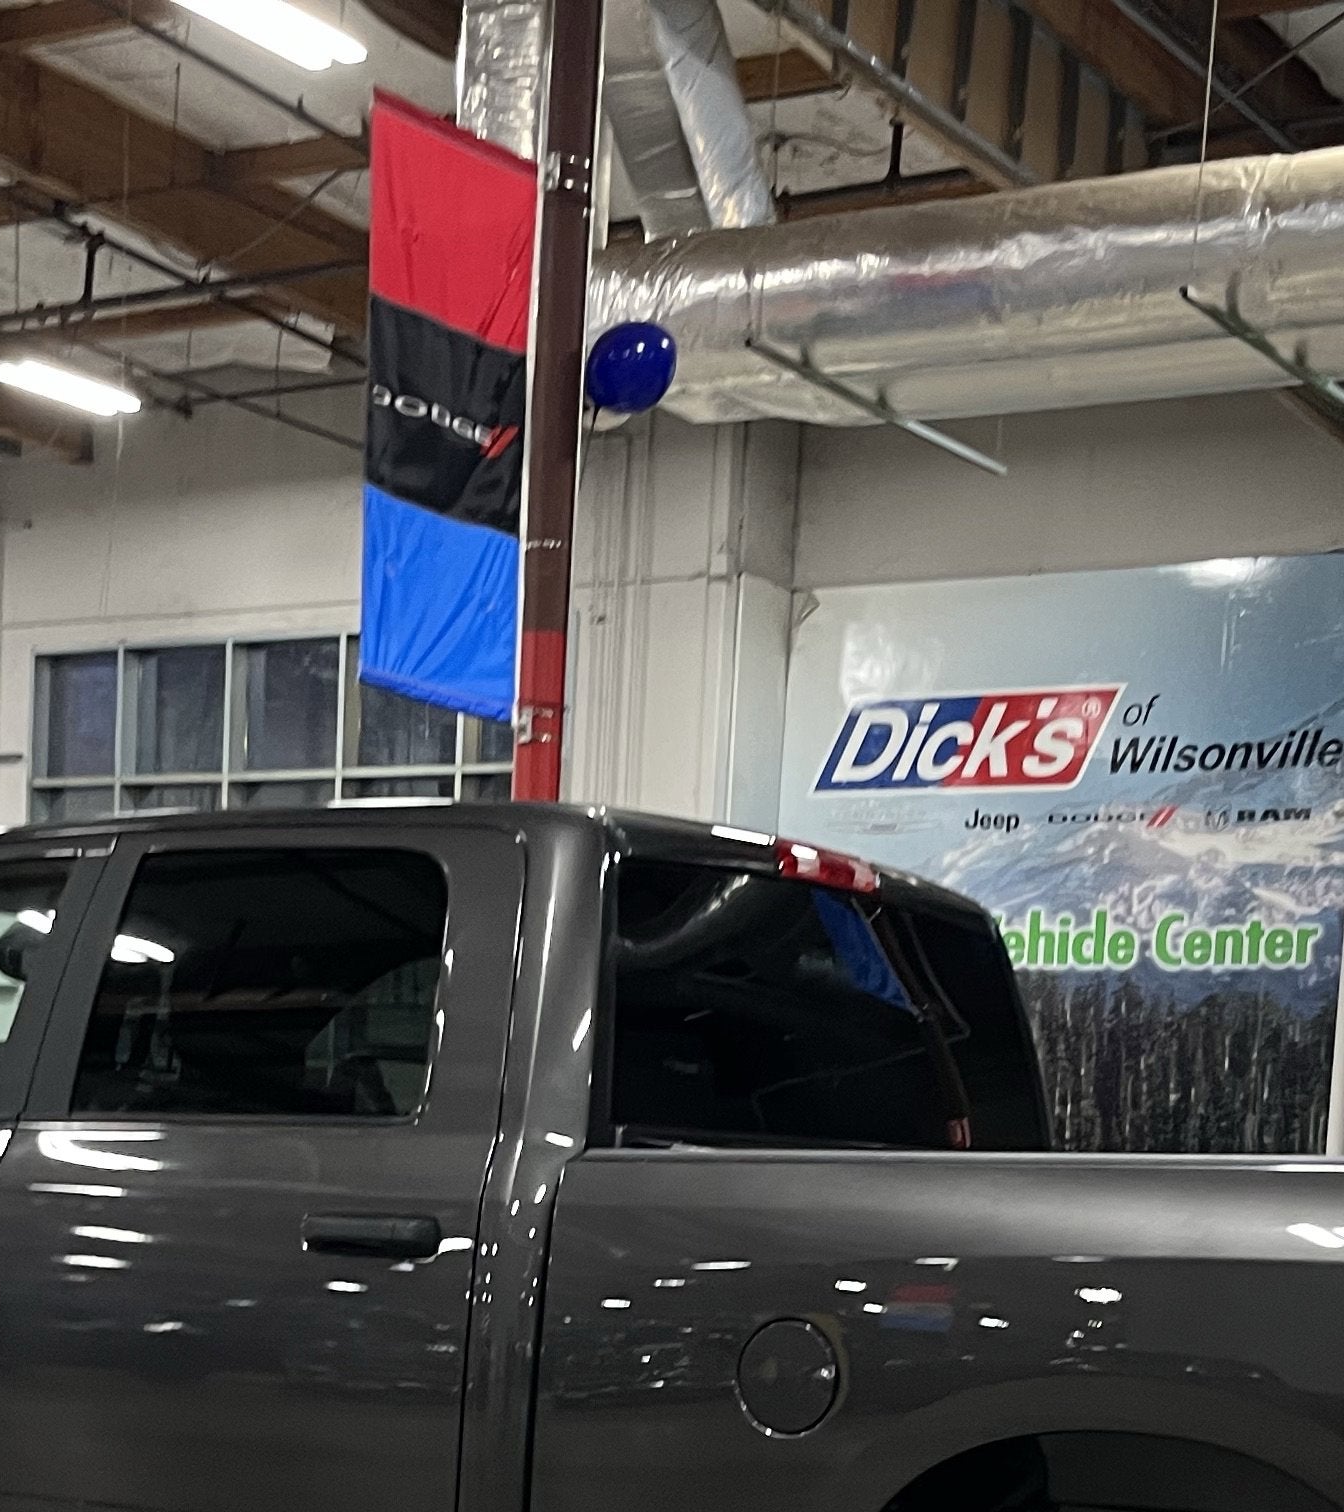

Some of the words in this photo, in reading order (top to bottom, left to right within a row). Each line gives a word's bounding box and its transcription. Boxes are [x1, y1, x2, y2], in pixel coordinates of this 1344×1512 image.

[828, 697, 1084, 784] Dick's
[1122, 694, 1159, 728] of
[1108, 732, 1344, 776] Wilsonville
[964, 808, 1020, 832] Jeep
[1236, 807, 1312, 822] RAM
[992, 909, 1135, 966] ehicle
[1156, 912, 1319, 966] Center
